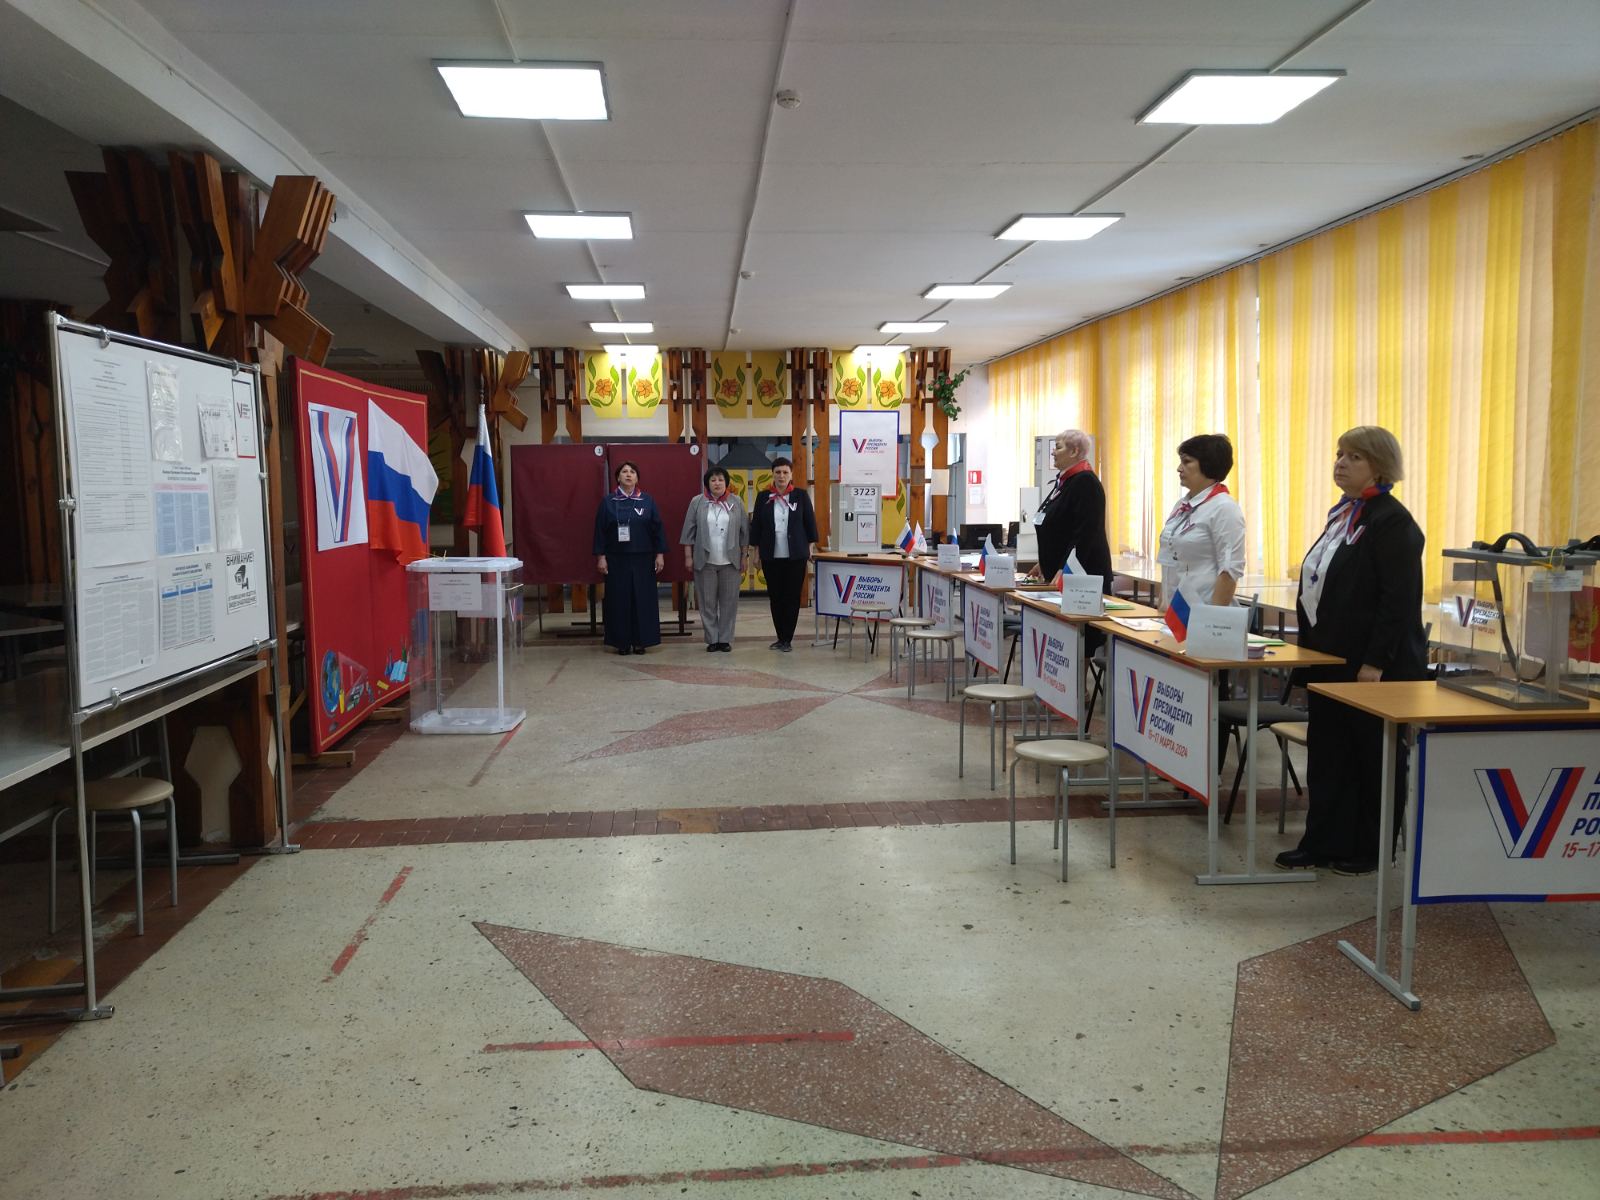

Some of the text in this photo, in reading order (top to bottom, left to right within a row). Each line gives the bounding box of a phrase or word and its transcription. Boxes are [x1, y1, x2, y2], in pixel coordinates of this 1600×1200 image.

[853, 488, 876, 496] 3723
[855, 583, 891, 593] ПРЕЗИДЕНТА
[858, 575, 884, 584] ВЫБОРЫ
[852, 591, 875, 600] РОССИИ
[1156, 681, 1184, 704] ВЫБОРЫ
[1153, 698, 1193, 727] ПРЕЗИДЕНТА
[1150, 713, 1175, 736] РОССИИ
[1159, 735, 1175, 751] МАРТА
[1175, 743, 1189, 758] 2024
[1570, 817, 1600, 836] РО
